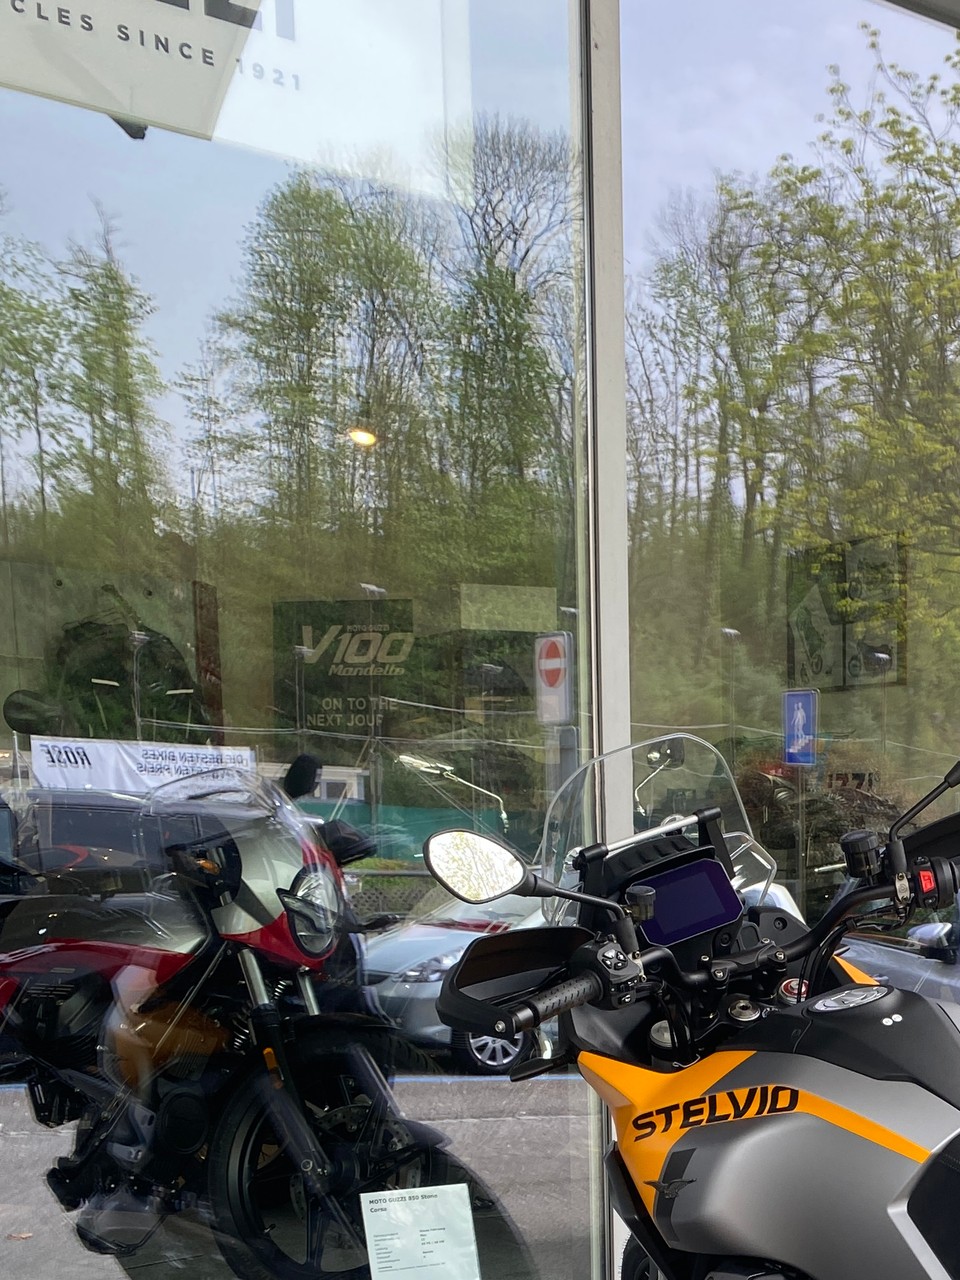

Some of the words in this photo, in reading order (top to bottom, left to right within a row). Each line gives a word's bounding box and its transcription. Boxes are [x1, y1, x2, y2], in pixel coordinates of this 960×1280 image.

[117, 24, 216, 67] SINCE
[235, 57, 301, 91] 1921
[302, 624, 415, 664] V100
[306, 714, 343, 727] NEXT
[321, 698, 342, 711] ON
[346, 698, 367, 711] TO
[370, 697, 399, 710] THE
[632, 1085, 800, 1143] STELVIO
